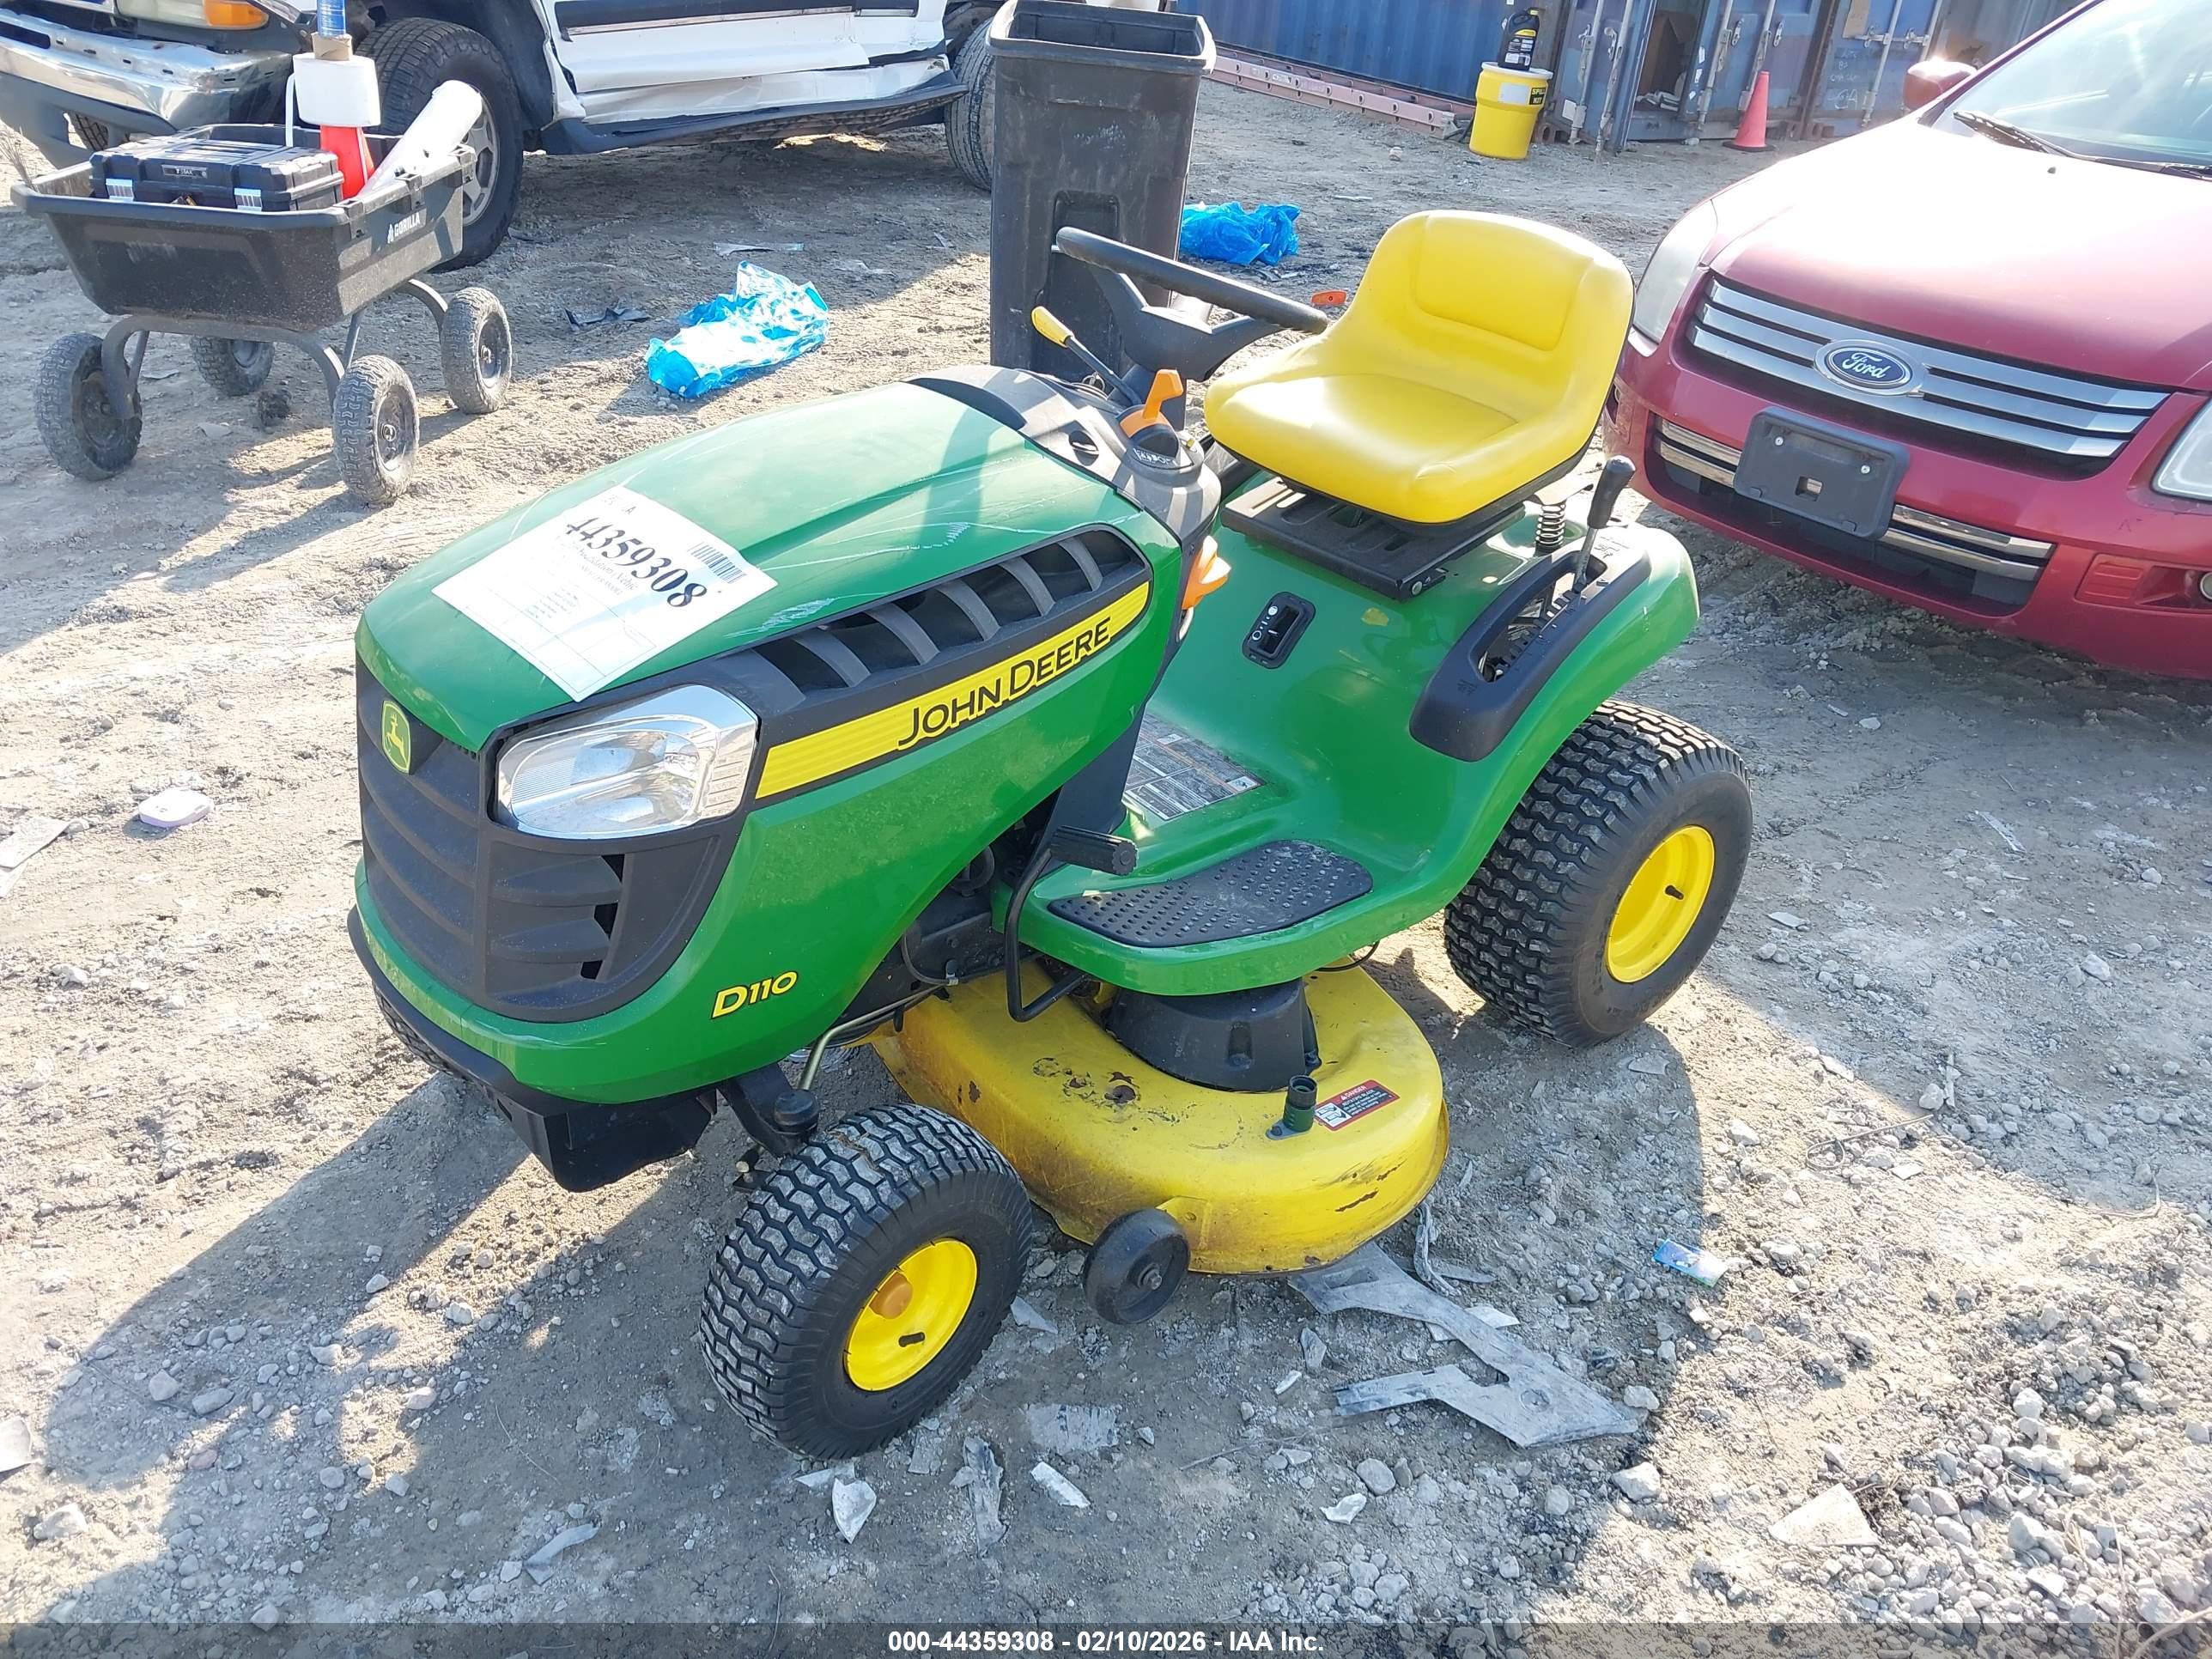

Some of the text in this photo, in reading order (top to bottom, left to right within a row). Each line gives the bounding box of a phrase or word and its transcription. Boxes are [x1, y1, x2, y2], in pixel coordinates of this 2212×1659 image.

[394, 211, 421, 237] GORILLA
[1842, 352, 1891, 379] Ford
[566, 517, 708, 607] 44359308
[898, 617, 1111, 746] JOHN DEERE
[711, 970, 799, 1019] D110
